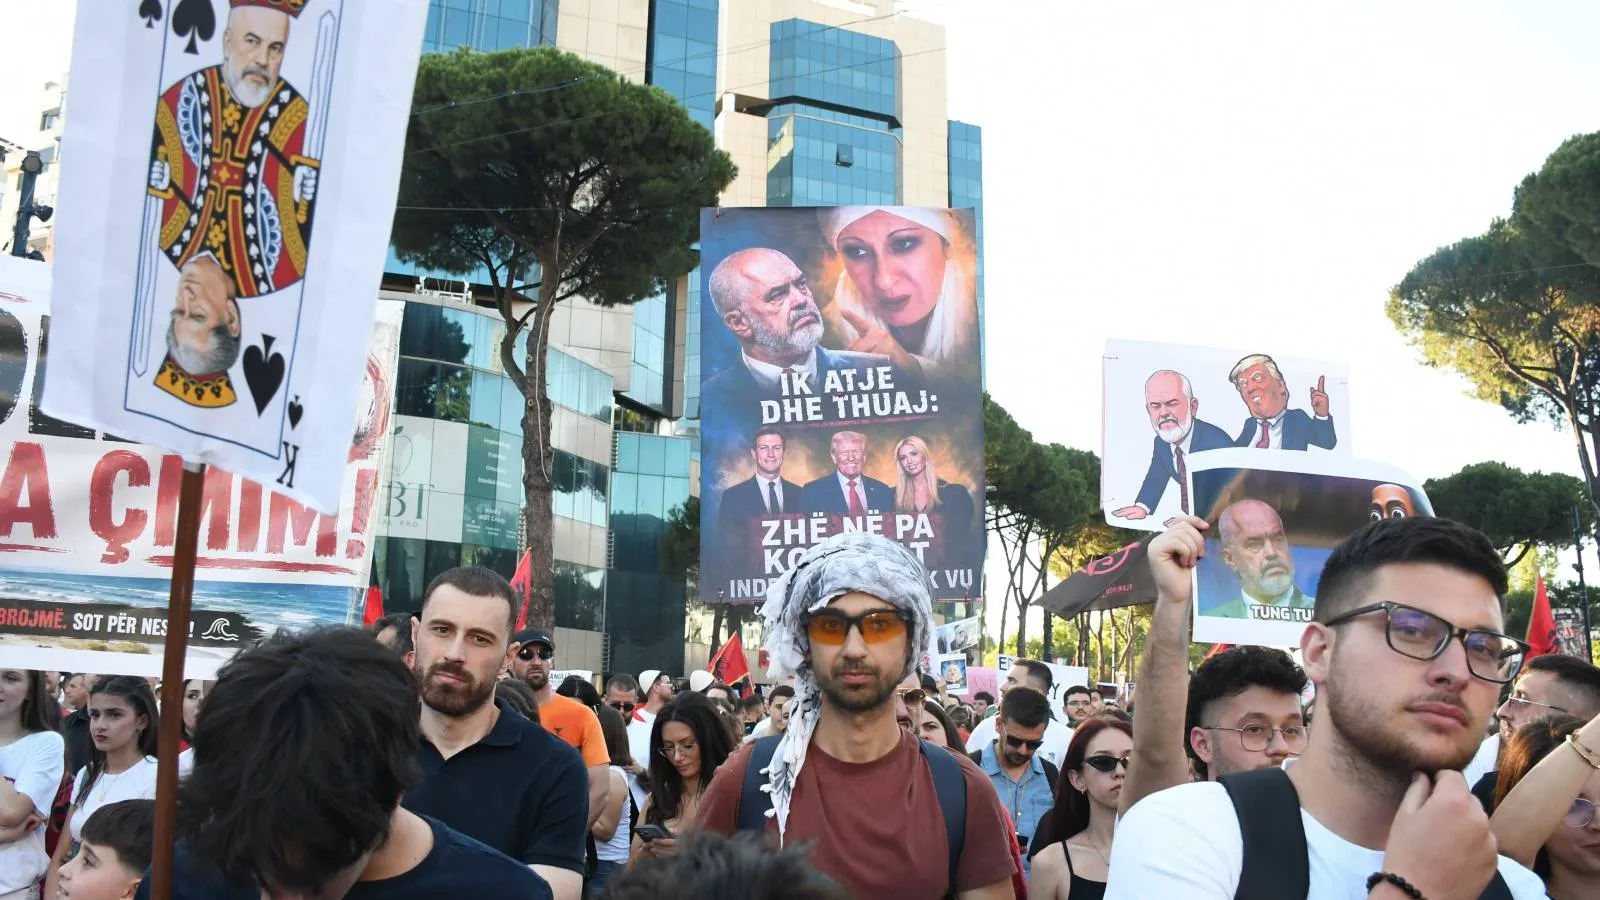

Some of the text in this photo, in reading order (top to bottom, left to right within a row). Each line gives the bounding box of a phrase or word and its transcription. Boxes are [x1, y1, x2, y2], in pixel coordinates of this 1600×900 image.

[780, 366, 895, 396] IK ATJE
[761, 390, 939, 425] DHE THUAJ:
[761, 510, 935, 547] ZHË NË PA
[945, 568, 973, 590] VU
[72, 612, 102, 632] SOT
[107, 612, 137, 634] PËR
[1251, 604, 1315, 622] TUNG TU
